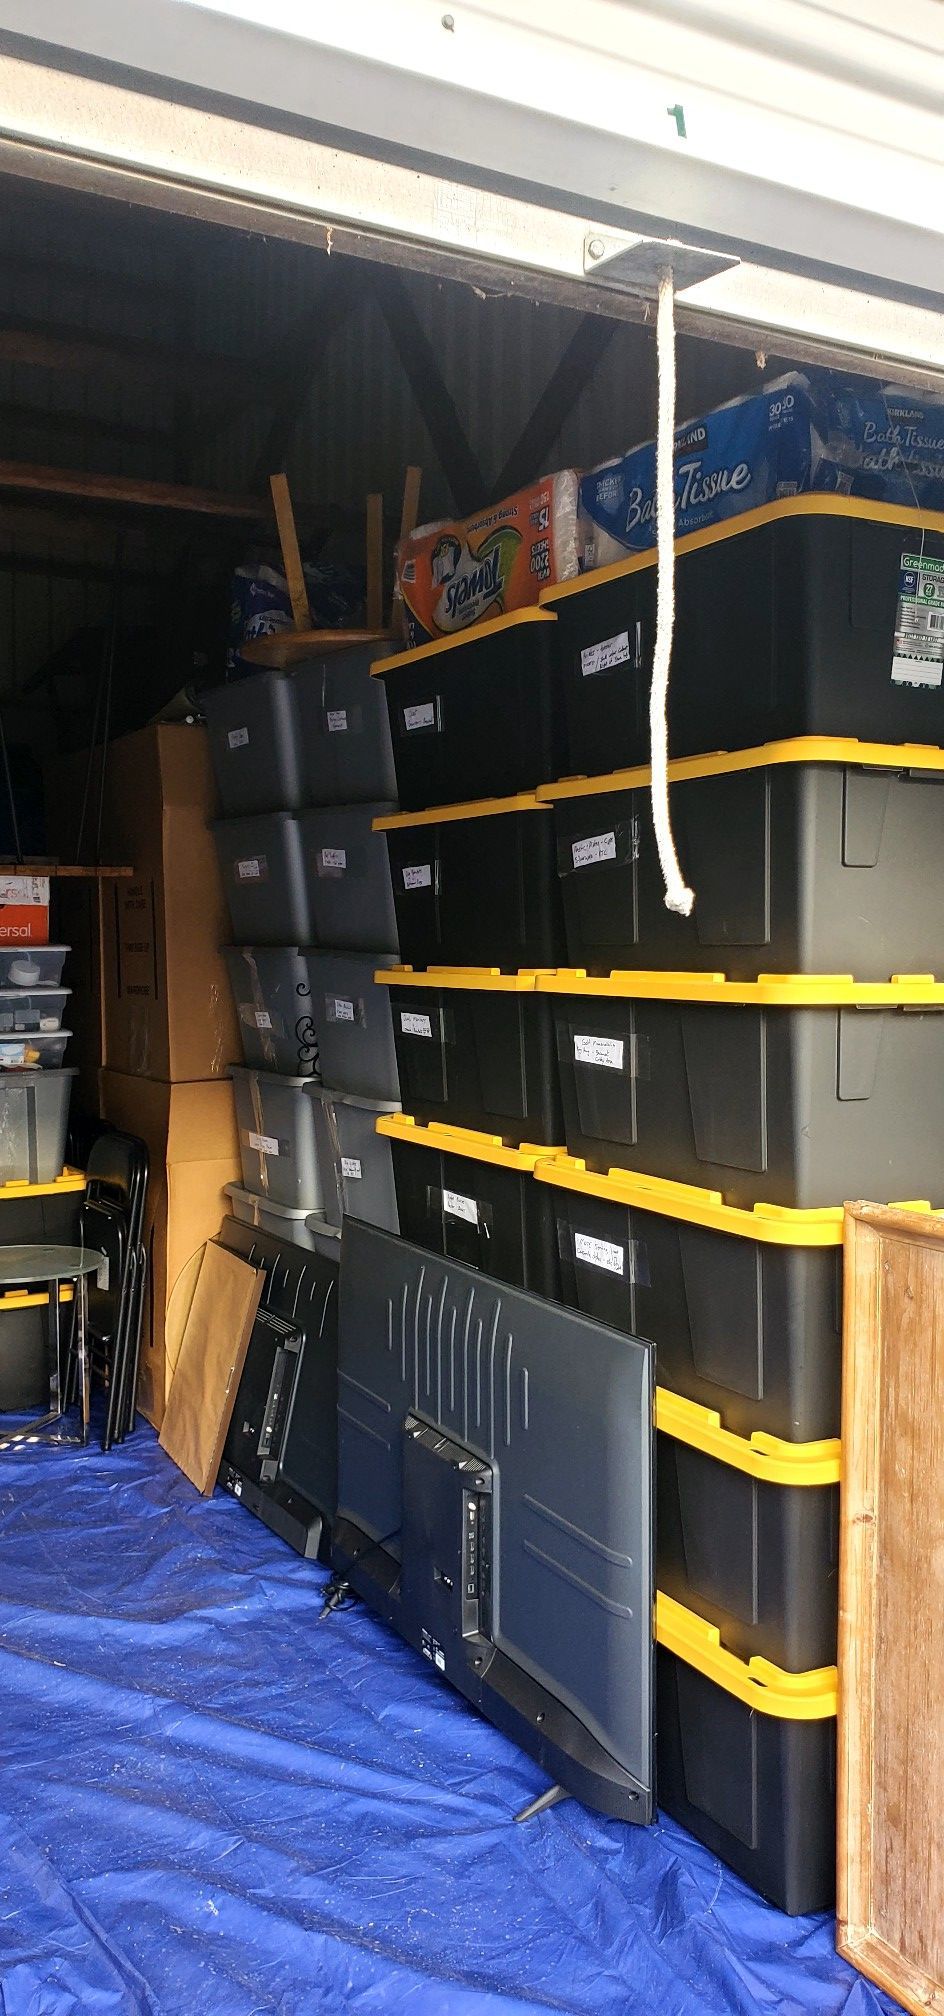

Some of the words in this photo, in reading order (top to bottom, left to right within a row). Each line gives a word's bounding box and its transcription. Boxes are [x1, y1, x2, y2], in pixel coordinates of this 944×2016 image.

[678, 461, 752, 510] Tissue
[498, 506, 519, 522] Strong
[446, 543, 505, 619] Towels
